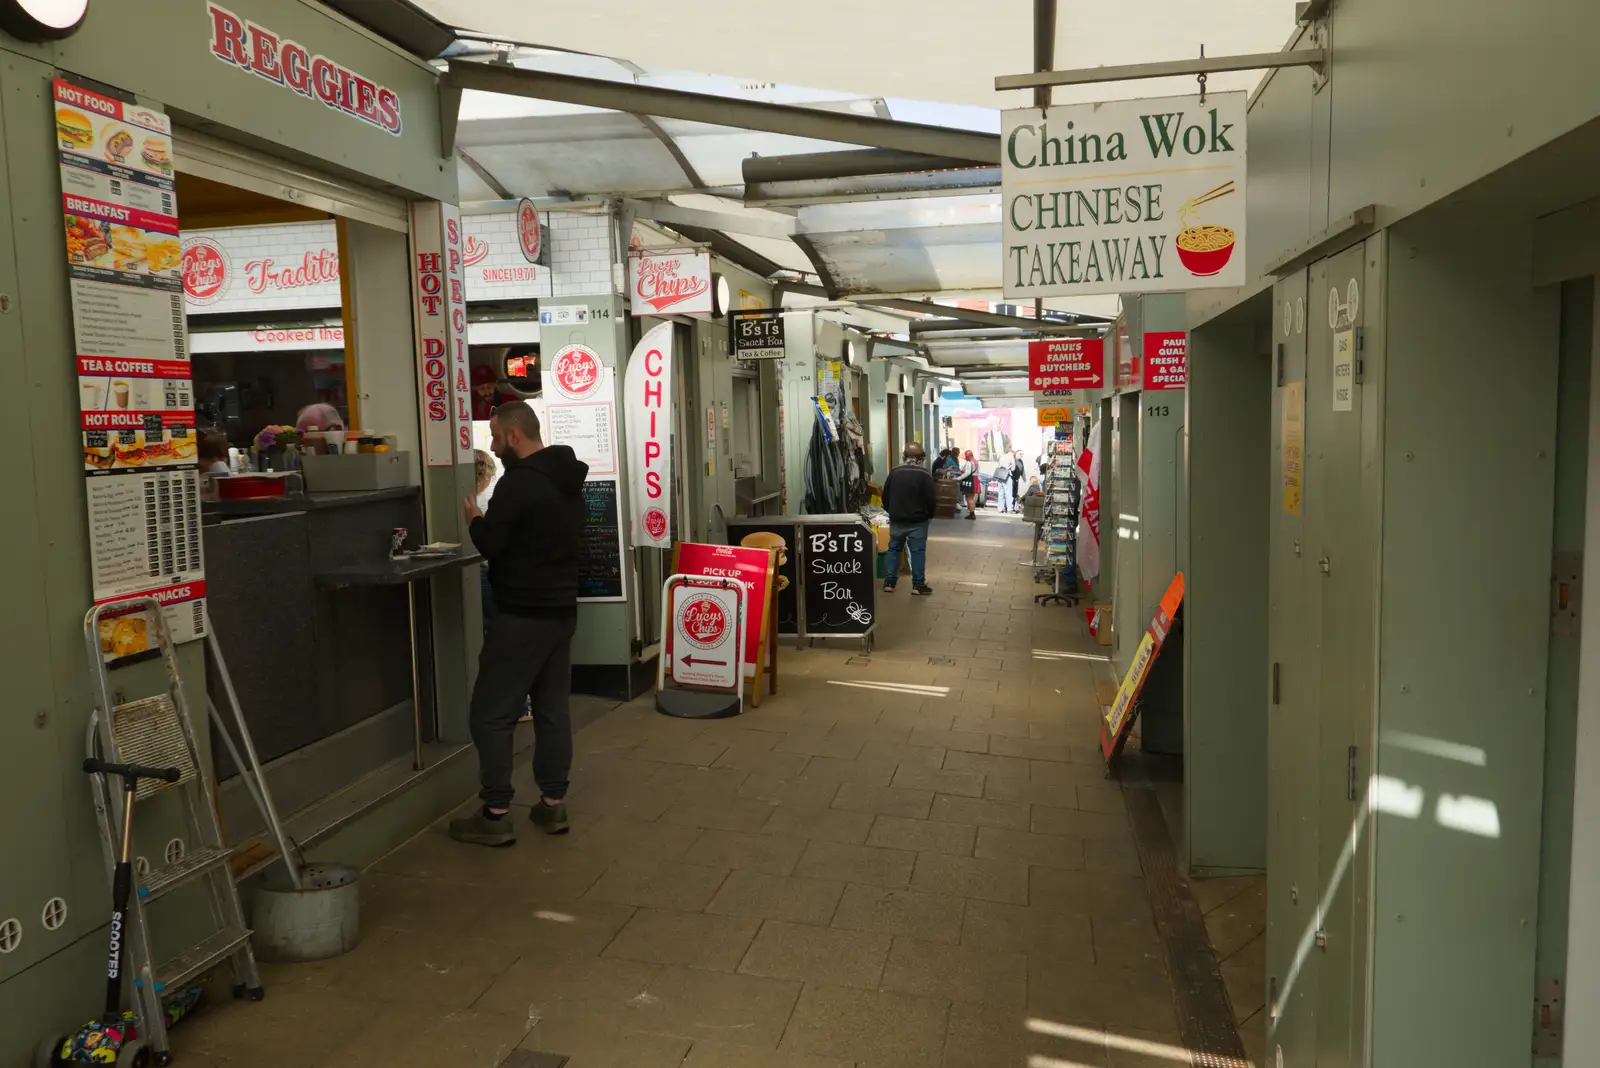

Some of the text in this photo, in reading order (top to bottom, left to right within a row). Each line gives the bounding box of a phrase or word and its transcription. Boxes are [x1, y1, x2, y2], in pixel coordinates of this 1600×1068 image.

[208, 3, 402, 136] REGGIES
[57, 86, 116, 114] HOT FOOD
[1007, 108, 1235, 169] China Wok
[66, 197, 131, 221] BREAKFAST
[1009, 184, 1164, 232] CHINESE
[1010, 234, 1167, 288] TAKEAWAY
[482, 268, 512, 282] SINCE
[636, 271, 702, 300] Chips
[590, 308, 610, 320] 114
[417, 252, 448, 422] HOT DOGS
[446, 217, 470, 450] SPECIALS
[738, 336, 784, 348] Snack Bar
[1048, 342, 1082, 352] PAUL'S
[1338, 338, 1348, 352] GAS
[760, 350, 782, 358] Coffee
[1047, 352, 1084, 362] FAMILY
[81, 359, 104, 372] TEA
[105, 361, 114, 372] &
[114, 362, 154, 374] COFFEE
[558, 358, 594, 377] Lucys
[1040, 362, 1091, 372] BUTCHERS
[1335, 363, 1351, 376] METERS
[564, 372, 594, 386] Chips
[1034, 375, 1070, 388] open
[1336, 388, 1349, 402] INSIDE
[1147, 406, 1169, 417] 113
[85, 414, 144, 426] HOT ROLLS
[644, 348, 663, 499] CHIPS
[702, 566, 742, 578] PICK UP
[812, 558, 862, 574] Snack
[151, 586, 192, 602] SNACKS
[820, 582, 854, 600] Bar
[685, 606, 722, 626] Lucys
[691, 622, 721, 637] Chips
[107, 911, 122, 979] SCOOTER
